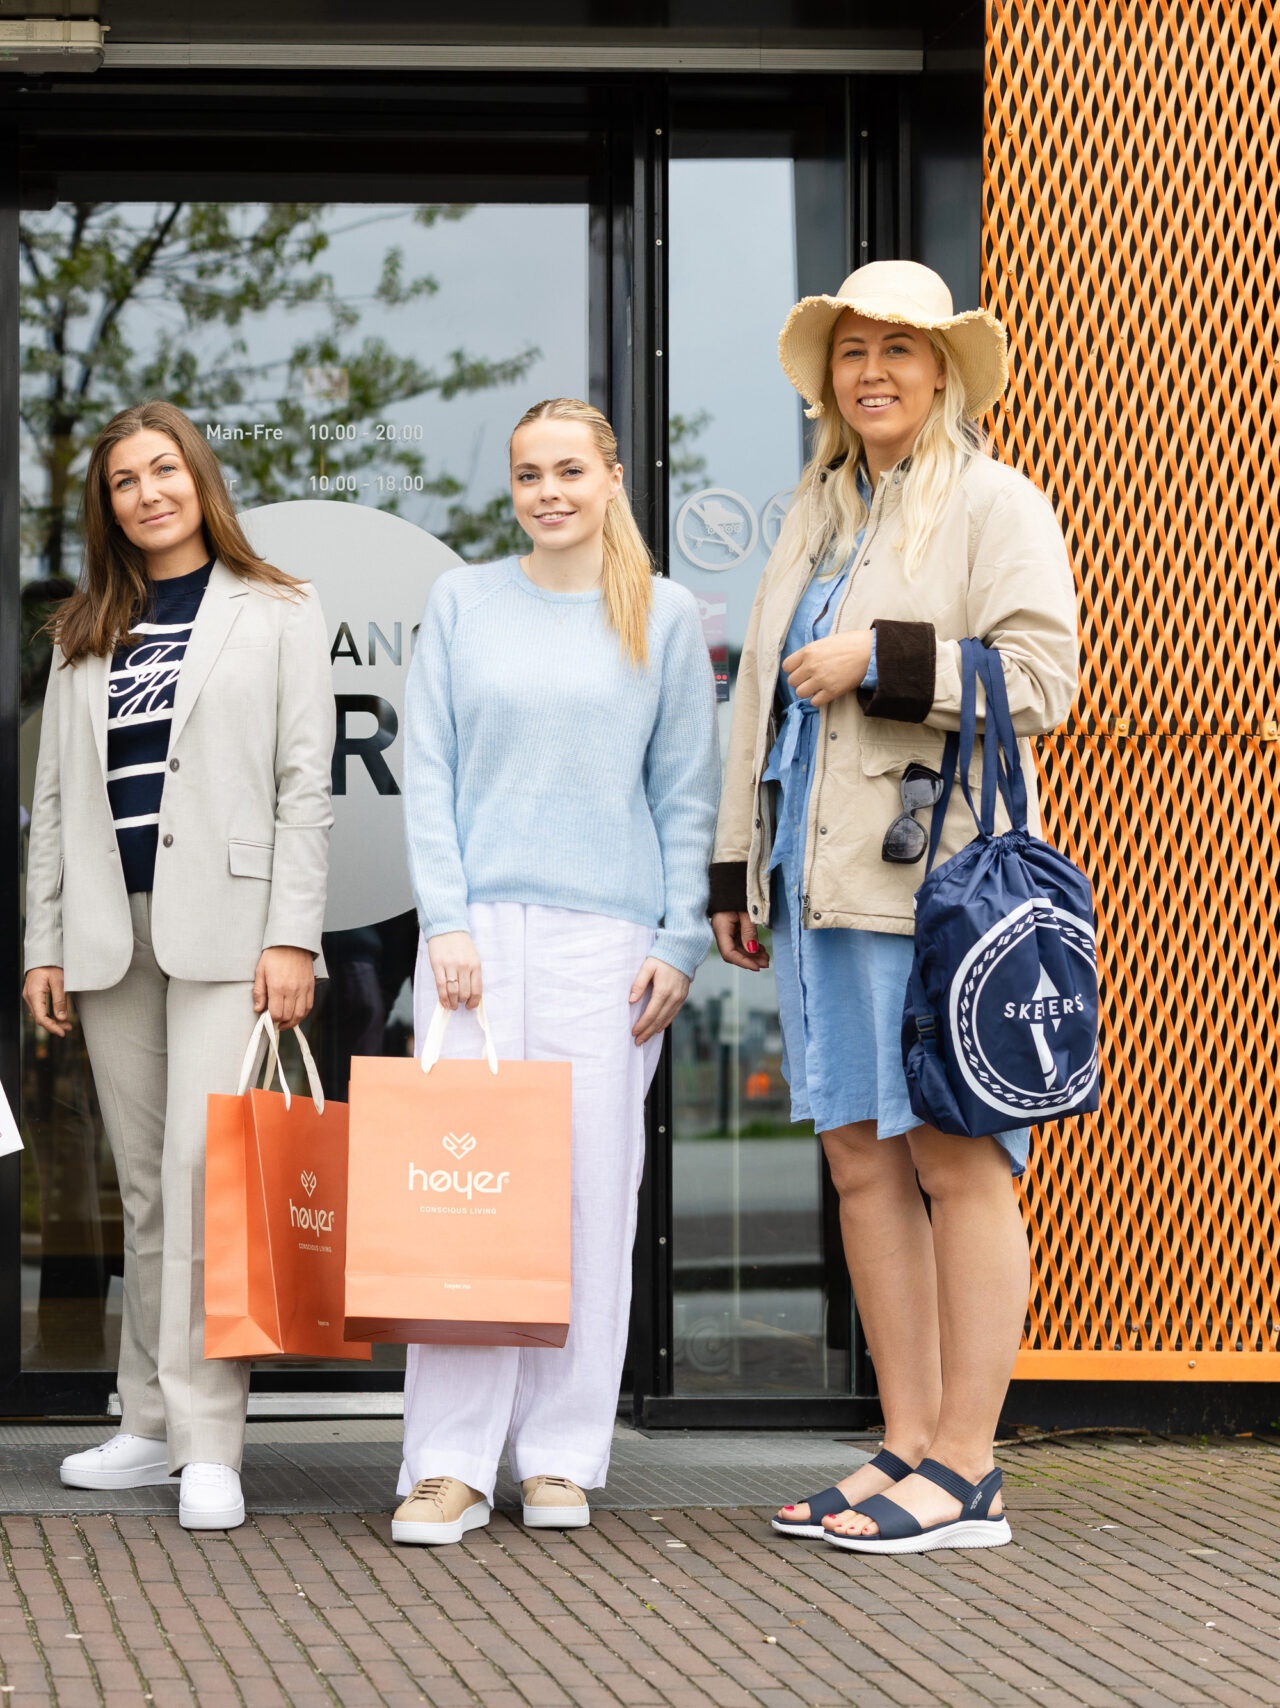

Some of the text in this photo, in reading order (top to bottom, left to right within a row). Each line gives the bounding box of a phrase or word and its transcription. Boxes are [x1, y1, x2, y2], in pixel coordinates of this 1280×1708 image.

[206, 424, 283, 441] Man-Fre
[309, 424, 357, 441] 10.00
[375, 424, 424, 441] 20.00
[309, 475, 357, 492] 10.00
[376, 475, 425, 492] 18.00
[408, 1162, 510, 1200] høyer
[419, 1205, 497, 1215] CONSCIOUS LIVING
